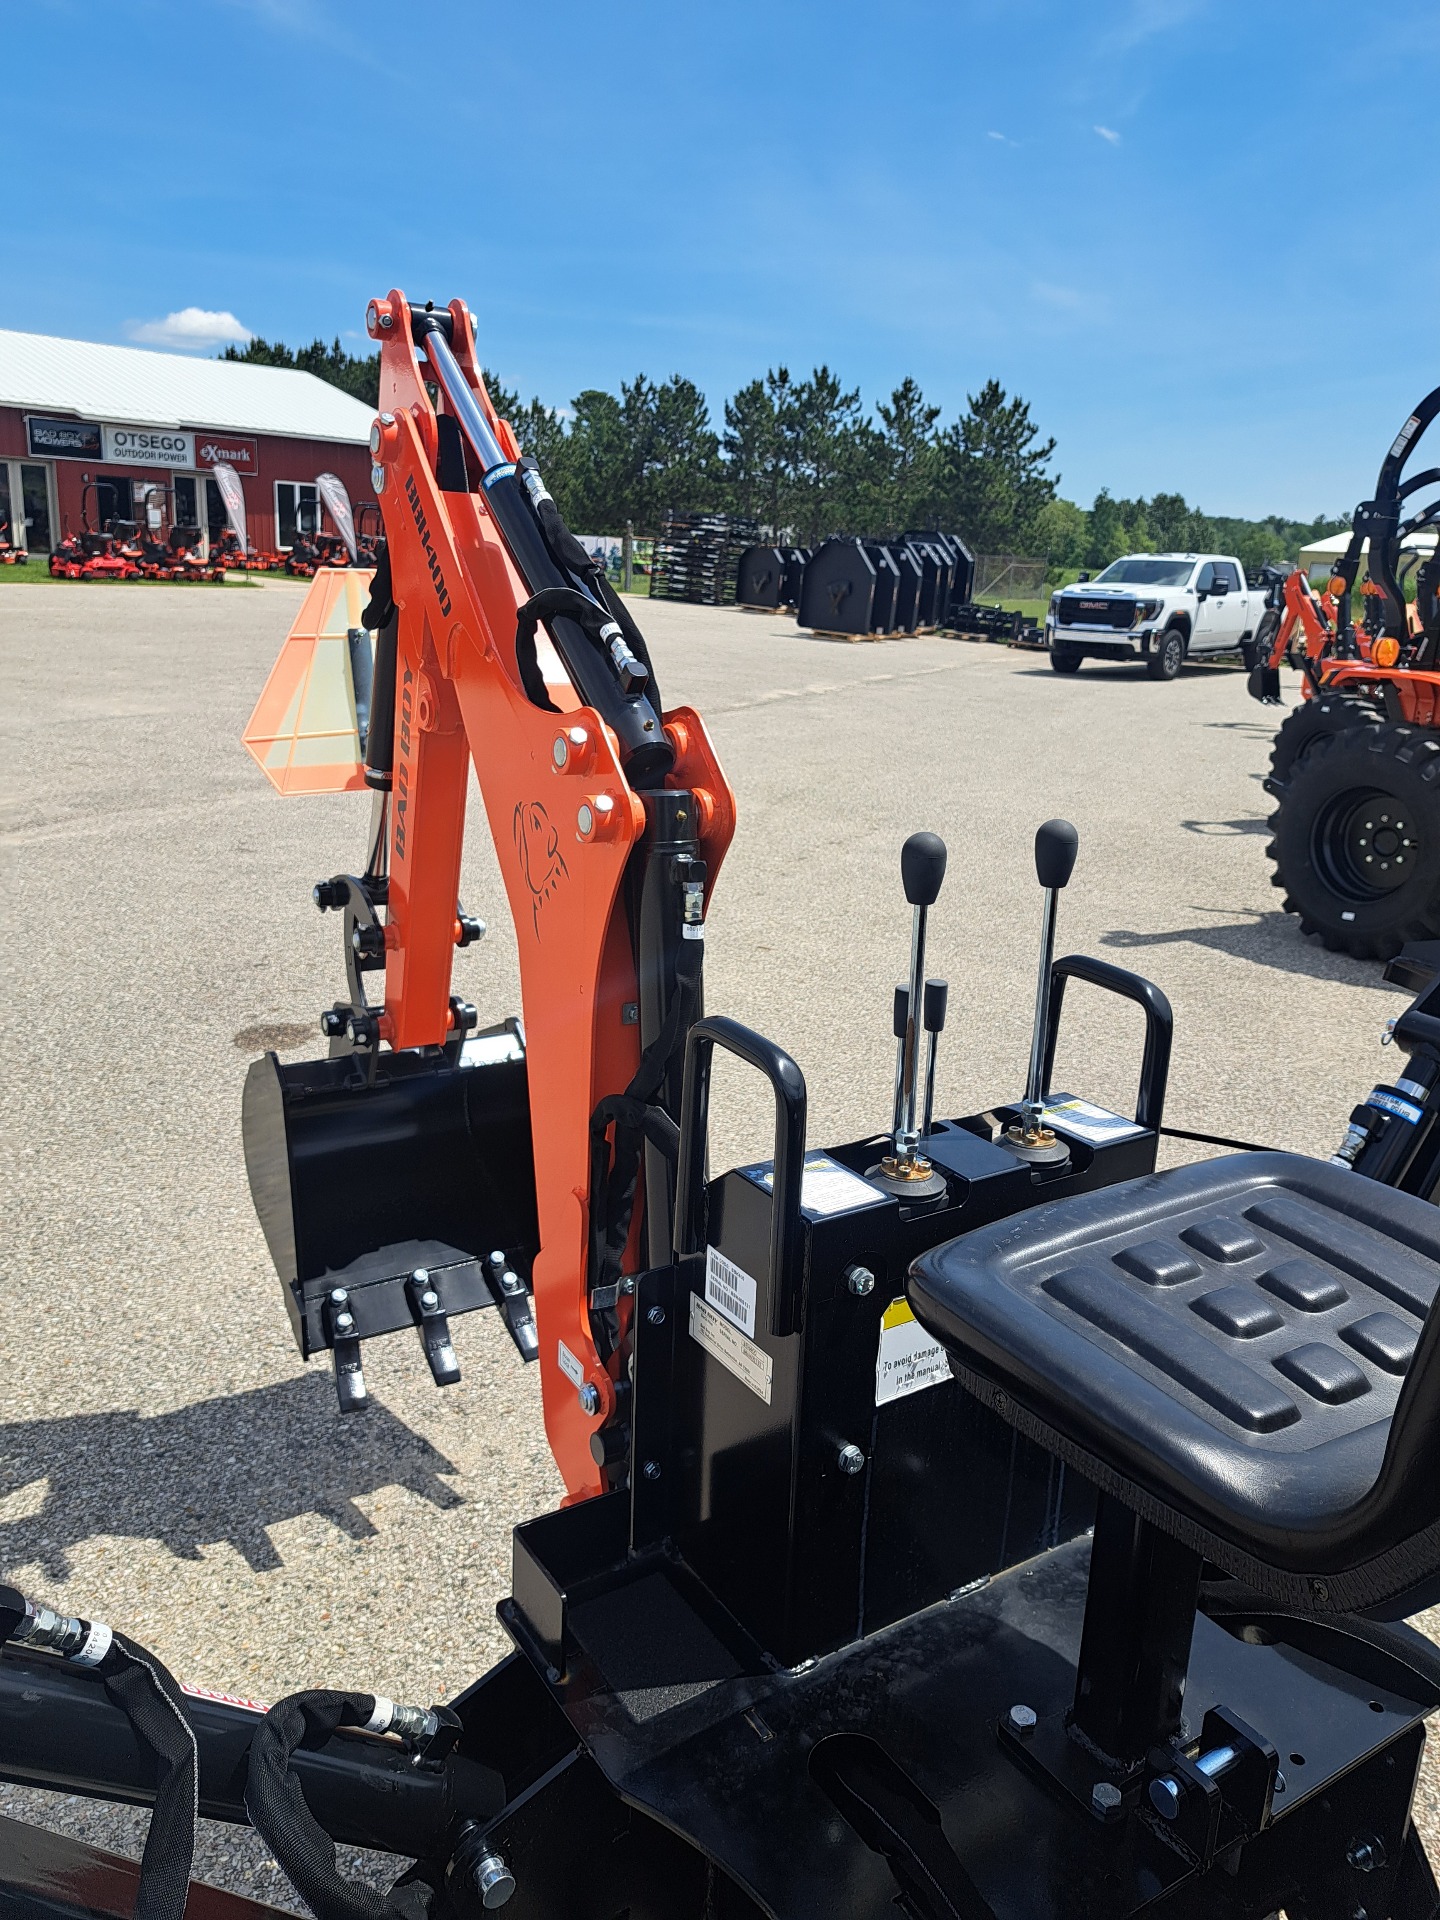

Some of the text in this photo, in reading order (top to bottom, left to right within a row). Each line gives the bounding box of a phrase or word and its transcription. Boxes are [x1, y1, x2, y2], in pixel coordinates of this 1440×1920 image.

[33, 428, 57, 438] BAD
[33, 437, 83, 448] MOWERS
[114, 432, 186, 451] OTSEGO
[113, 447, 188, 463] OUTDOOR POWER
[1079, 601, 1108, 610] GMC
[395, 654, 414, 861] BAD BOY
[884, 1361, 892, 1371] To
[893, 1354, 912, 1368] avoid
[913, 1346, 940, 1361] damage
[896, 1375, 903, 1386] in
[904, 1371, 915, 1382] the
